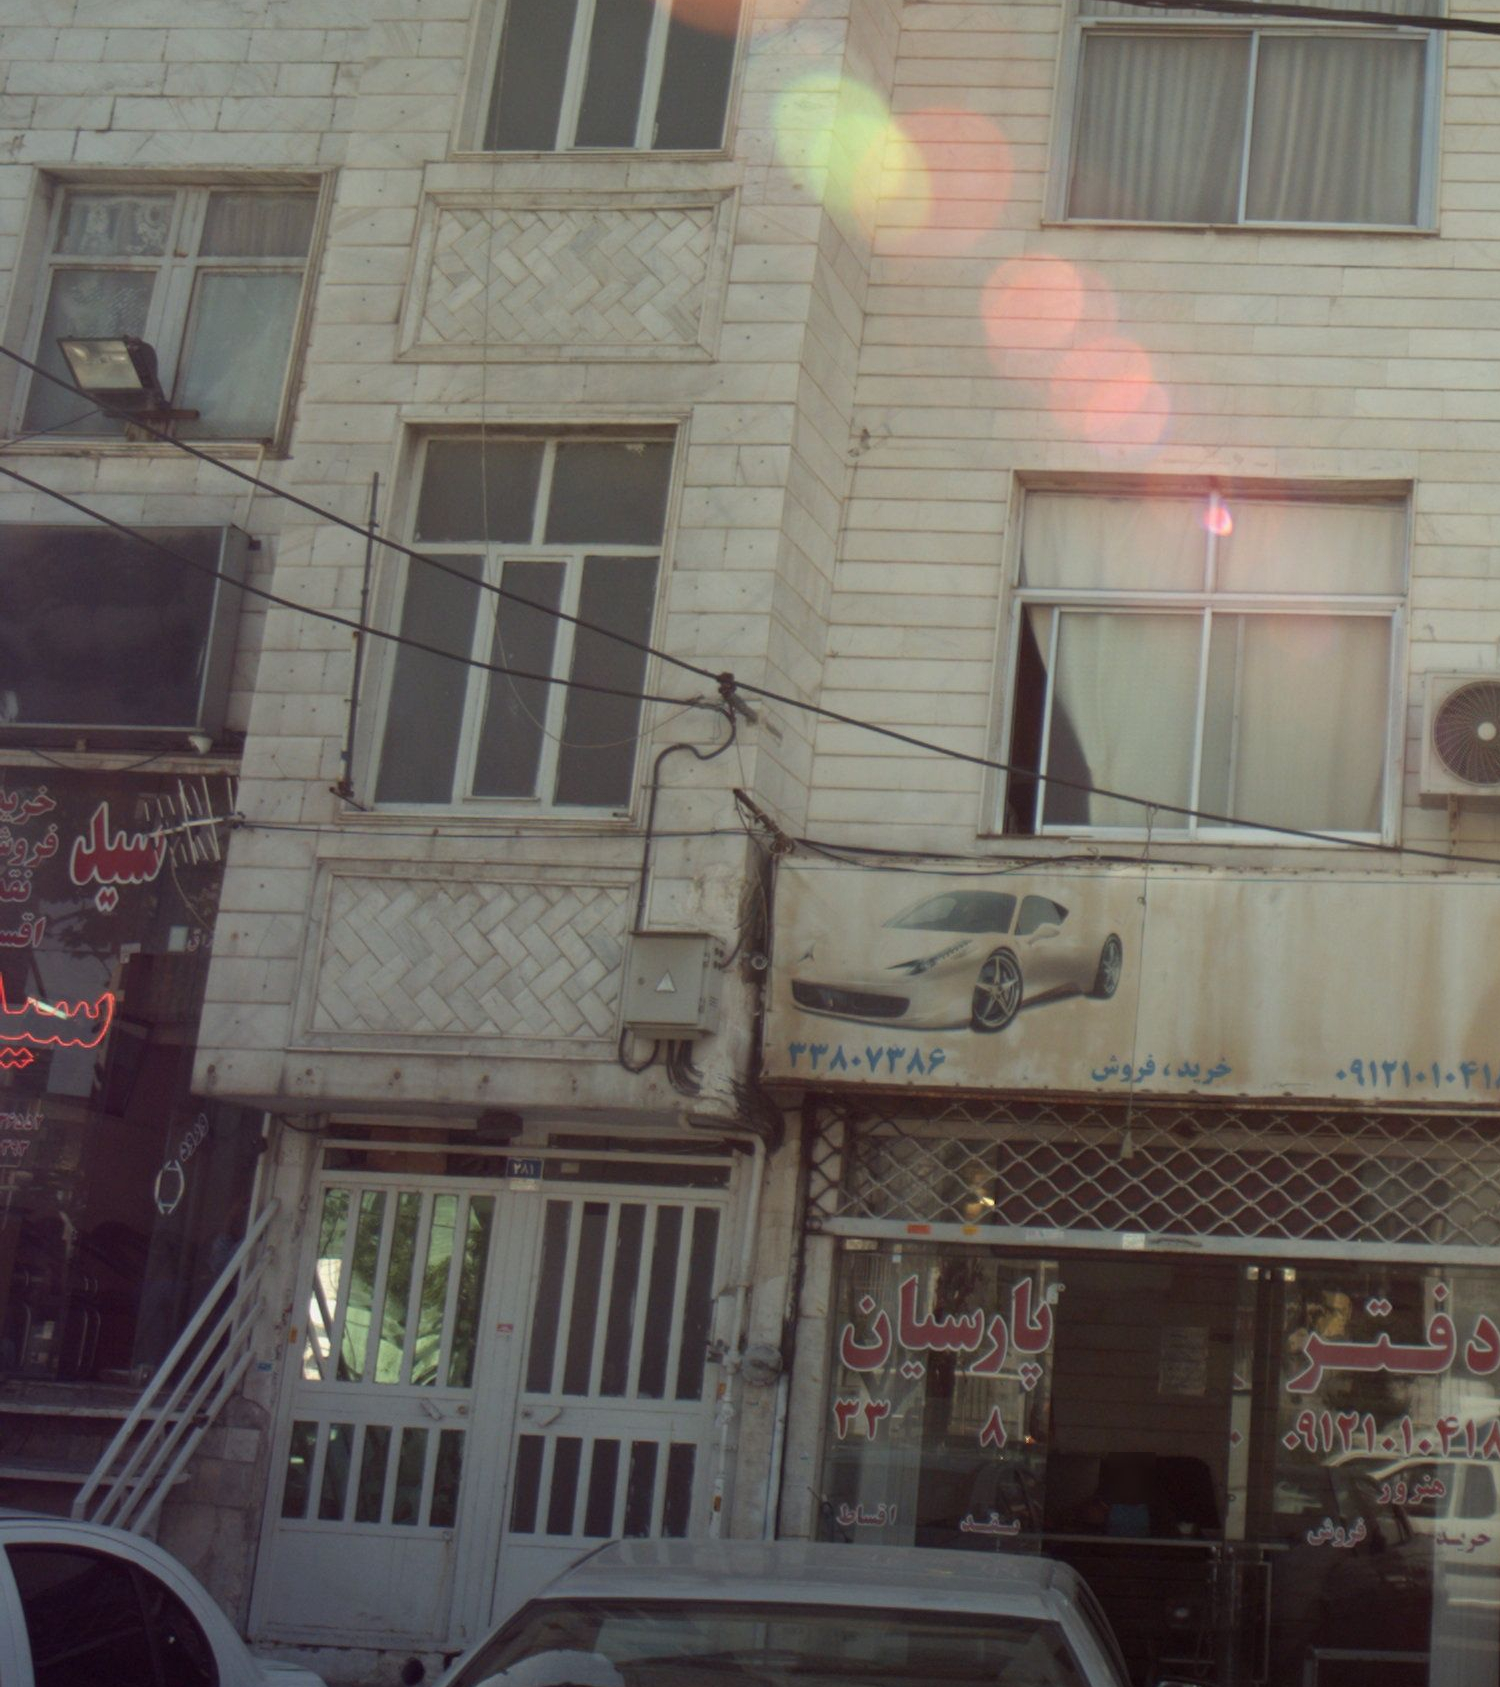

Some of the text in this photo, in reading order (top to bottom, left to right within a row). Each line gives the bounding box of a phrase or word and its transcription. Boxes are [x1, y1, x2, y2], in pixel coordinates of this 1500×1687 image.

[788, 1042, 946, 1075] ۳۳۸۰۷۳۸۶
[841, 1275, 1053, 1391] پارسیان
[1307, 1517, 1367, 1548] فروش
